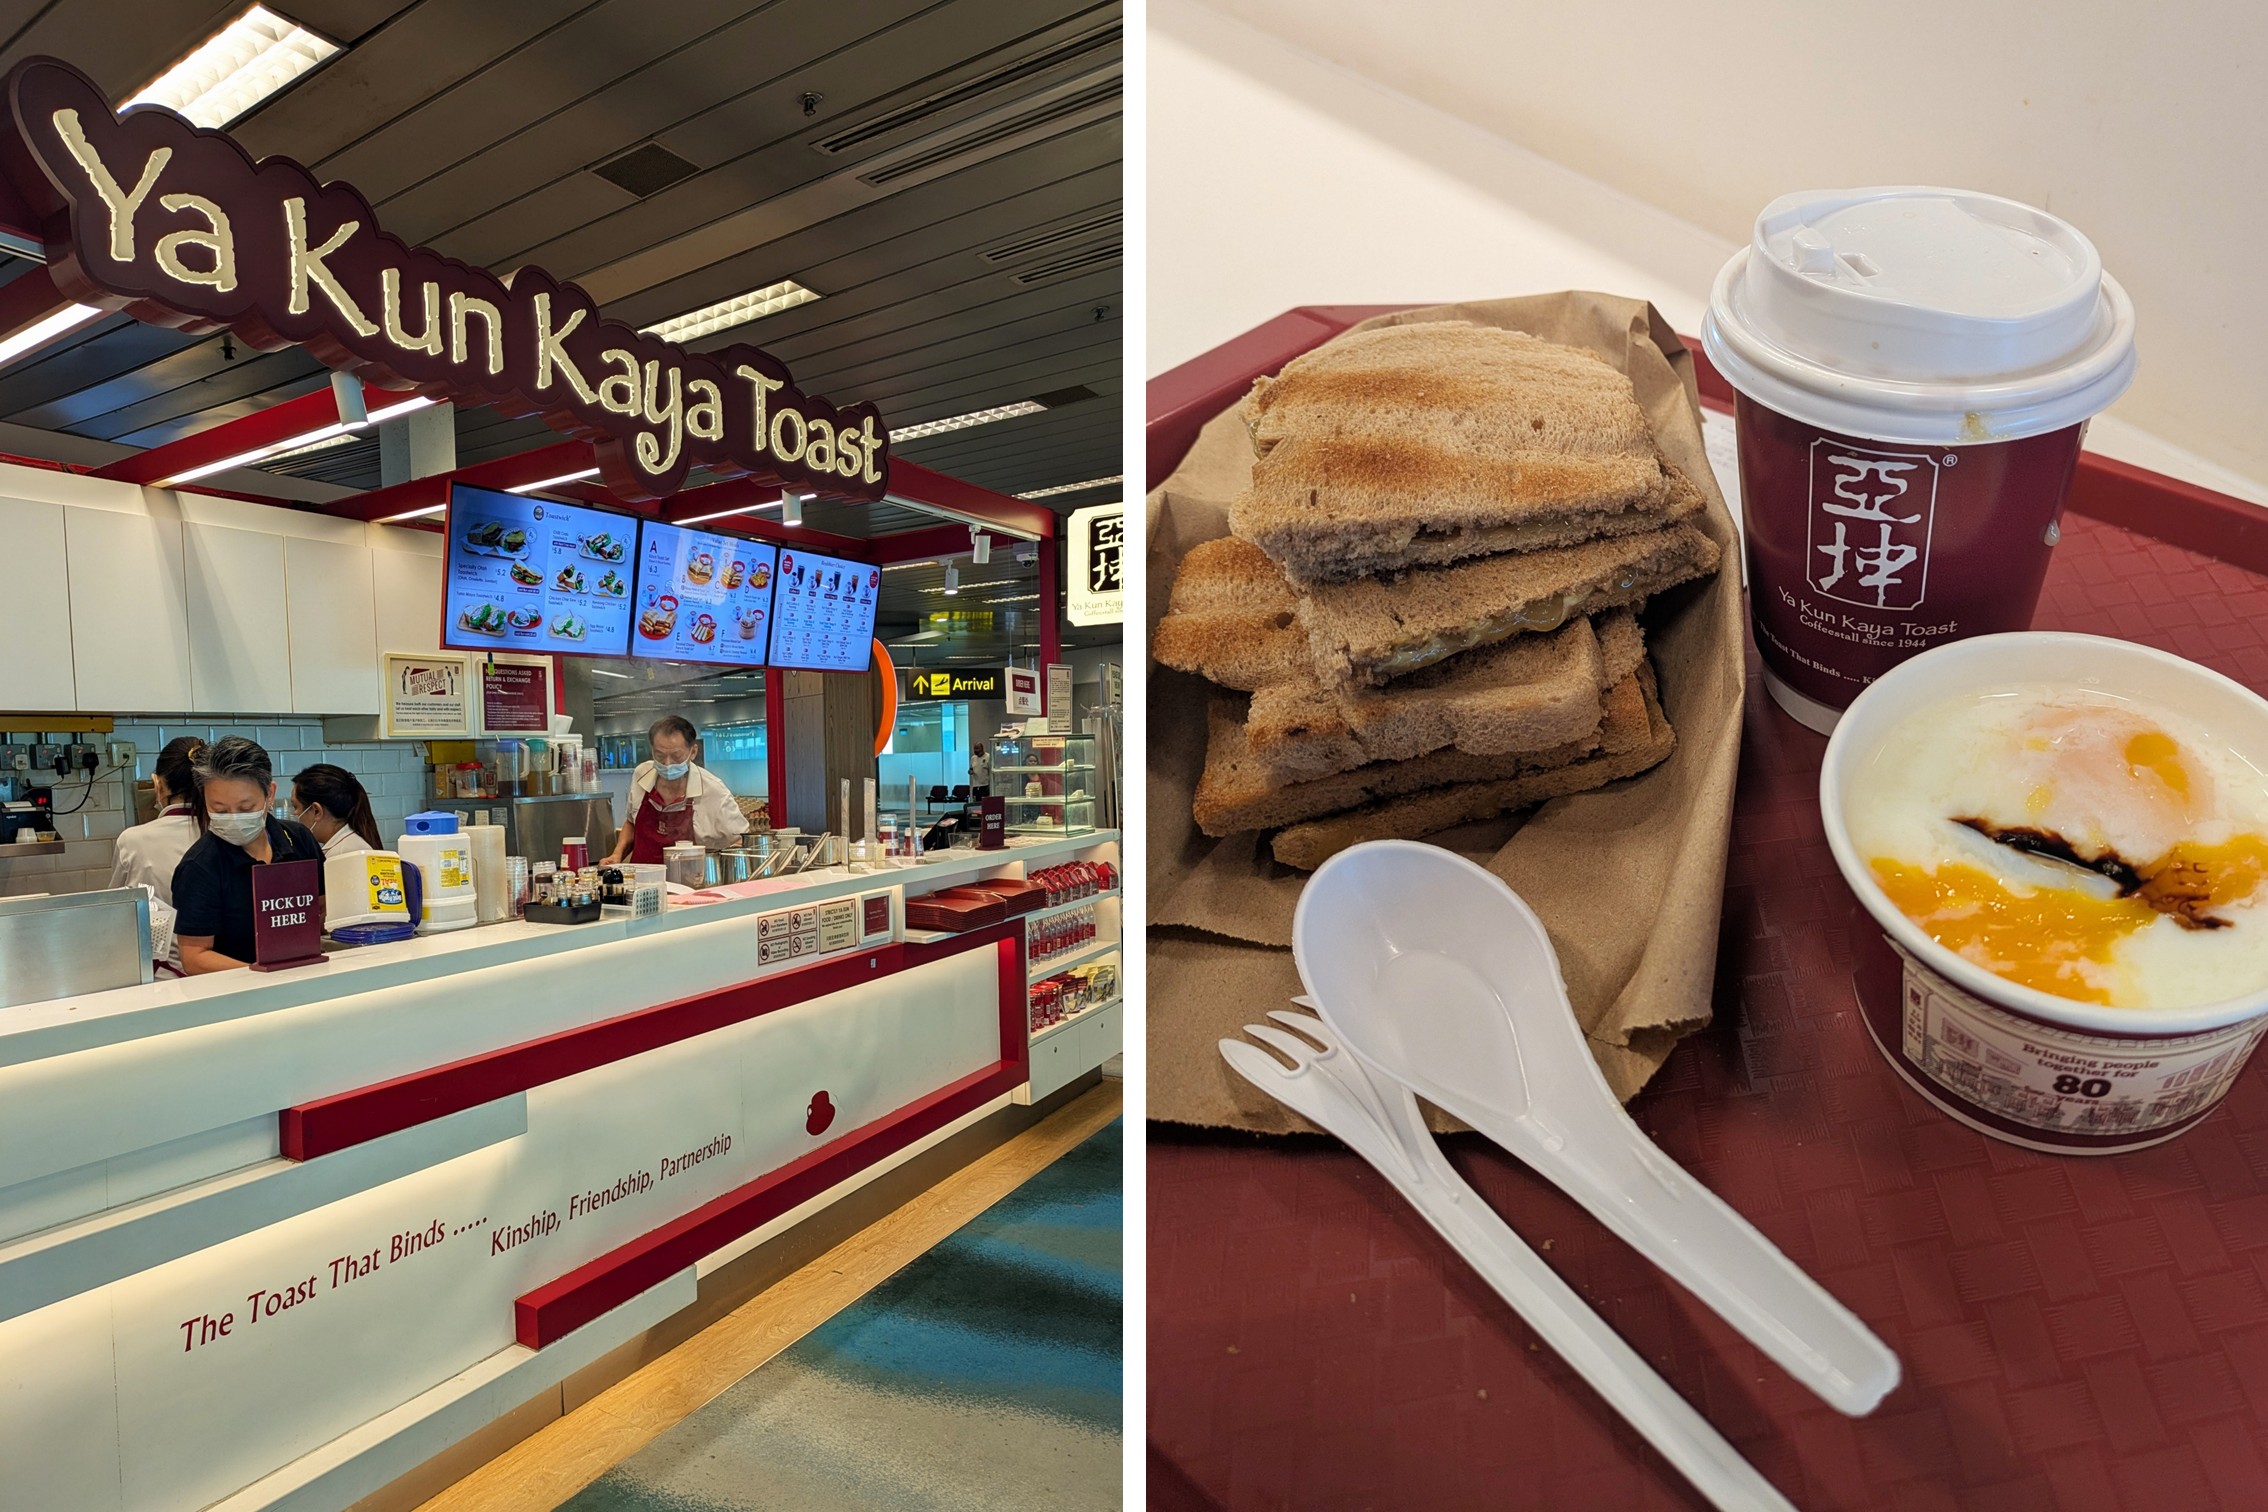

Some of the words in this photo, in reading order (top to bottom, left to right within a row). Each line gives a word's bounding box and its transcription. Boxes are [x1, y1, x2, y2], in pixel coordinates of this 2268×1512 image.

[52, 108, 238, 293] Ya
[284, 197, 504, 375] Kun
[533, 292, 724, 476] Kaya
[737, 364, 883, 485] Toast
[650, 540, 657, 554] A
[1778, 586, 1796, 608] Ya
[1800, 599, 1836, 625] Kun
[1842, 614, 1894, 640] Kaya
[1900, 620, 1958, 636] Toast
[676, 632, 680, 641] E
[1800, 614, 1860, 643] Coffeestall
[1862, 638, 1895, 648] since
[1898, 639, 1926, 648] 1944
[1770, 633, 1789, 654] Toast
[1790, 648, 1810, 666] That
[1813, 661, 1841, 678] Binds
[410, 671, 436, 685] MUTUAL
[419, 679, 446, 694] RESPECT
[952, 676, 994, 691] Arrival
[261, 897, 295, 912] PICK
[296, 894, 314, 908] UP
[270, 912, 306, 928] HERE
[2022, 1043, 2098, 1068] Bringing
[2102, 1060, 2160, 1070] people
[2037, 1058, 2110, 1077] together
[2112, 1070, 2140, 1078] for
[2052, 1074, 2112, 1098] 80
[490, 1209, 562, 1256] Kinship,
[569, 1170, 654, 1220] Friendship,
[660, 1133, 732, 1180] Partnership
[180, 1312, 234, 1352] The
[247, 1275, 318, 1324] Toast
[328, 1247, 381, 1289] That
[390, 1219, 446, 1264] Binds
